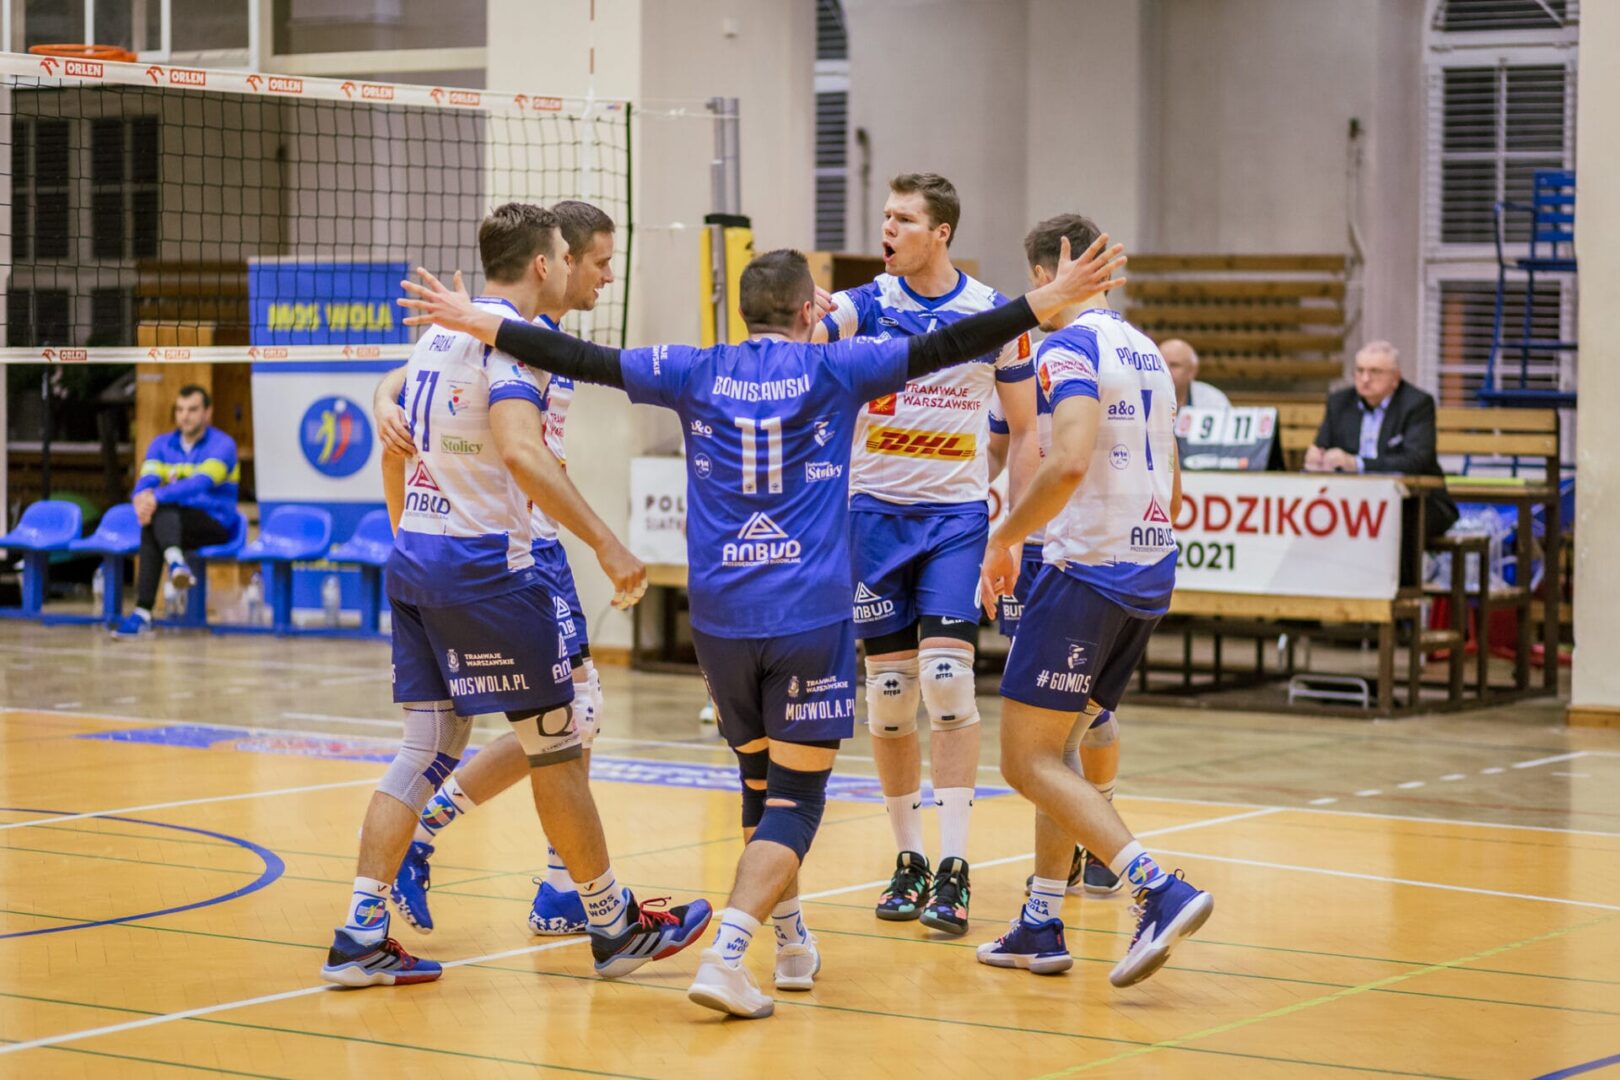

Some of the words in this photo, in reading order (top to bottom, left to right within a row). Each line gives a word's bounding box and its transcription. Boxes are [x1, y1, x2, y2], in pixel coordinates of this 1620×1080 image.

[66, 62, 102, 77] ORLEN
[170, 70, 205, 84] ORLEN
[269, 78, 302, 92] ORLEN
[362, 85, 394, 99] ORLEN
[268, 303, 320, 332] MOS
[326, 303, 393, 332] WOLA
[712, 373, 811, 402] BONISAWSKI
[905, 383, 969, 397] TRAMWAJE
[1108, 400, 1135, 415] a&o
[1200, 416, 1214, 439] 9
[1234, 416, 1252, 439] 11
[879, 431, 965, 457] DHL
[735, 417, 782, 494] 11
[1172, 487, 1388, 538] ODZIKÓW
[723, 540, 801, 562] ANBUD
[449, 674, 530, 697] MOSWOLA.PL
[588, 899, 620, 917] WOLA
[589, 894, 614, 909] MOS
